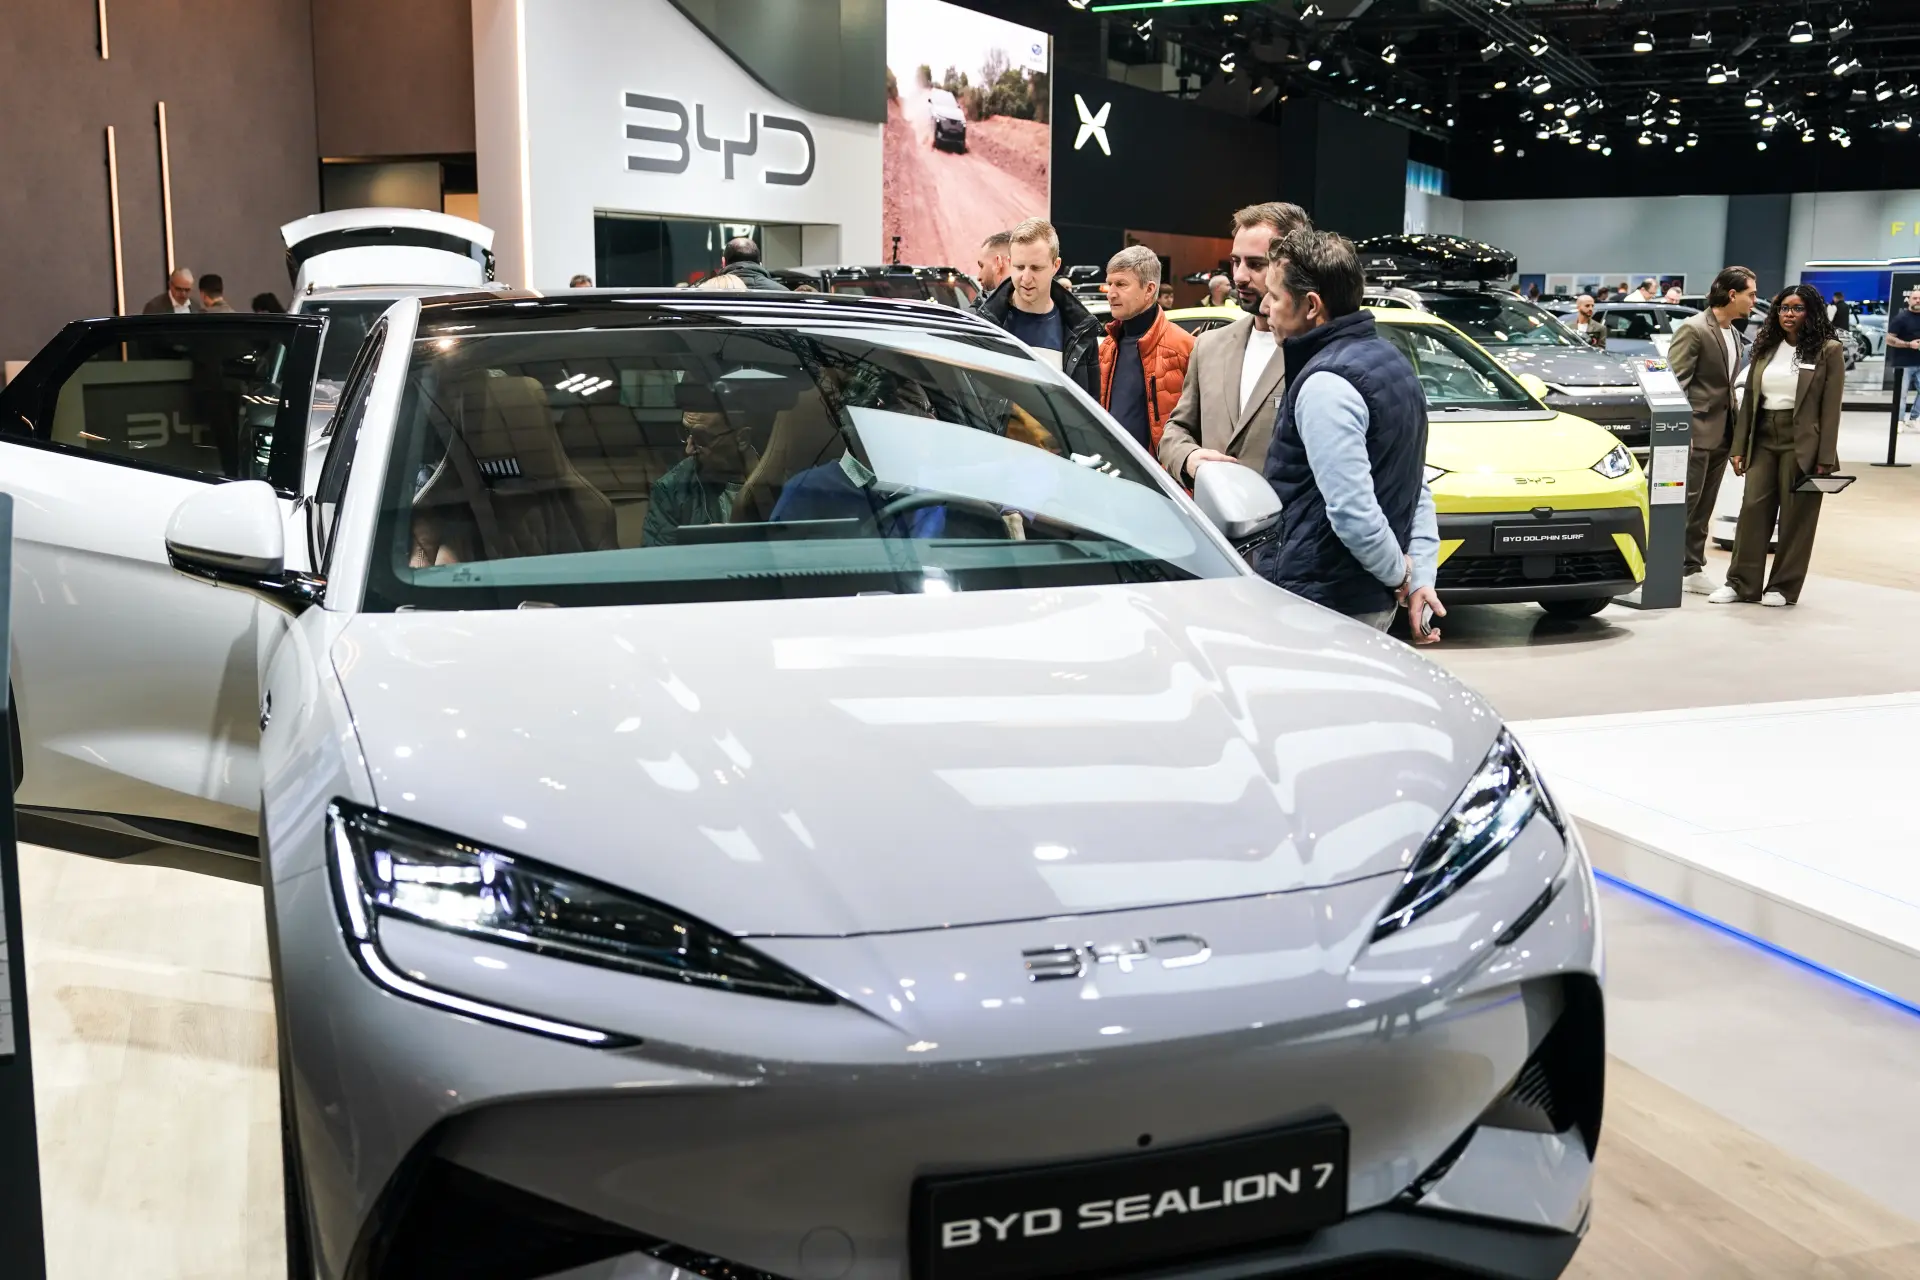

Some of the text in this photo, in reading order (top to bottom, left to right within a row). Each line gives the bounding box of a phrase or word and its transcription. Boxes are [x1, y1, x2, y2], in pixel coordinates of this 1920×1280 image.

[625, 92, 816, 186] BYD
[1655, 422, 1690, 432] BYD
[1513, 476, 1556, 485] BYD
[1561, 533, 1585, 541] SURF
[1022, 933, 1213, 983] BYD
[942, 1162, 1334, 1249] BYD SEALION 7
